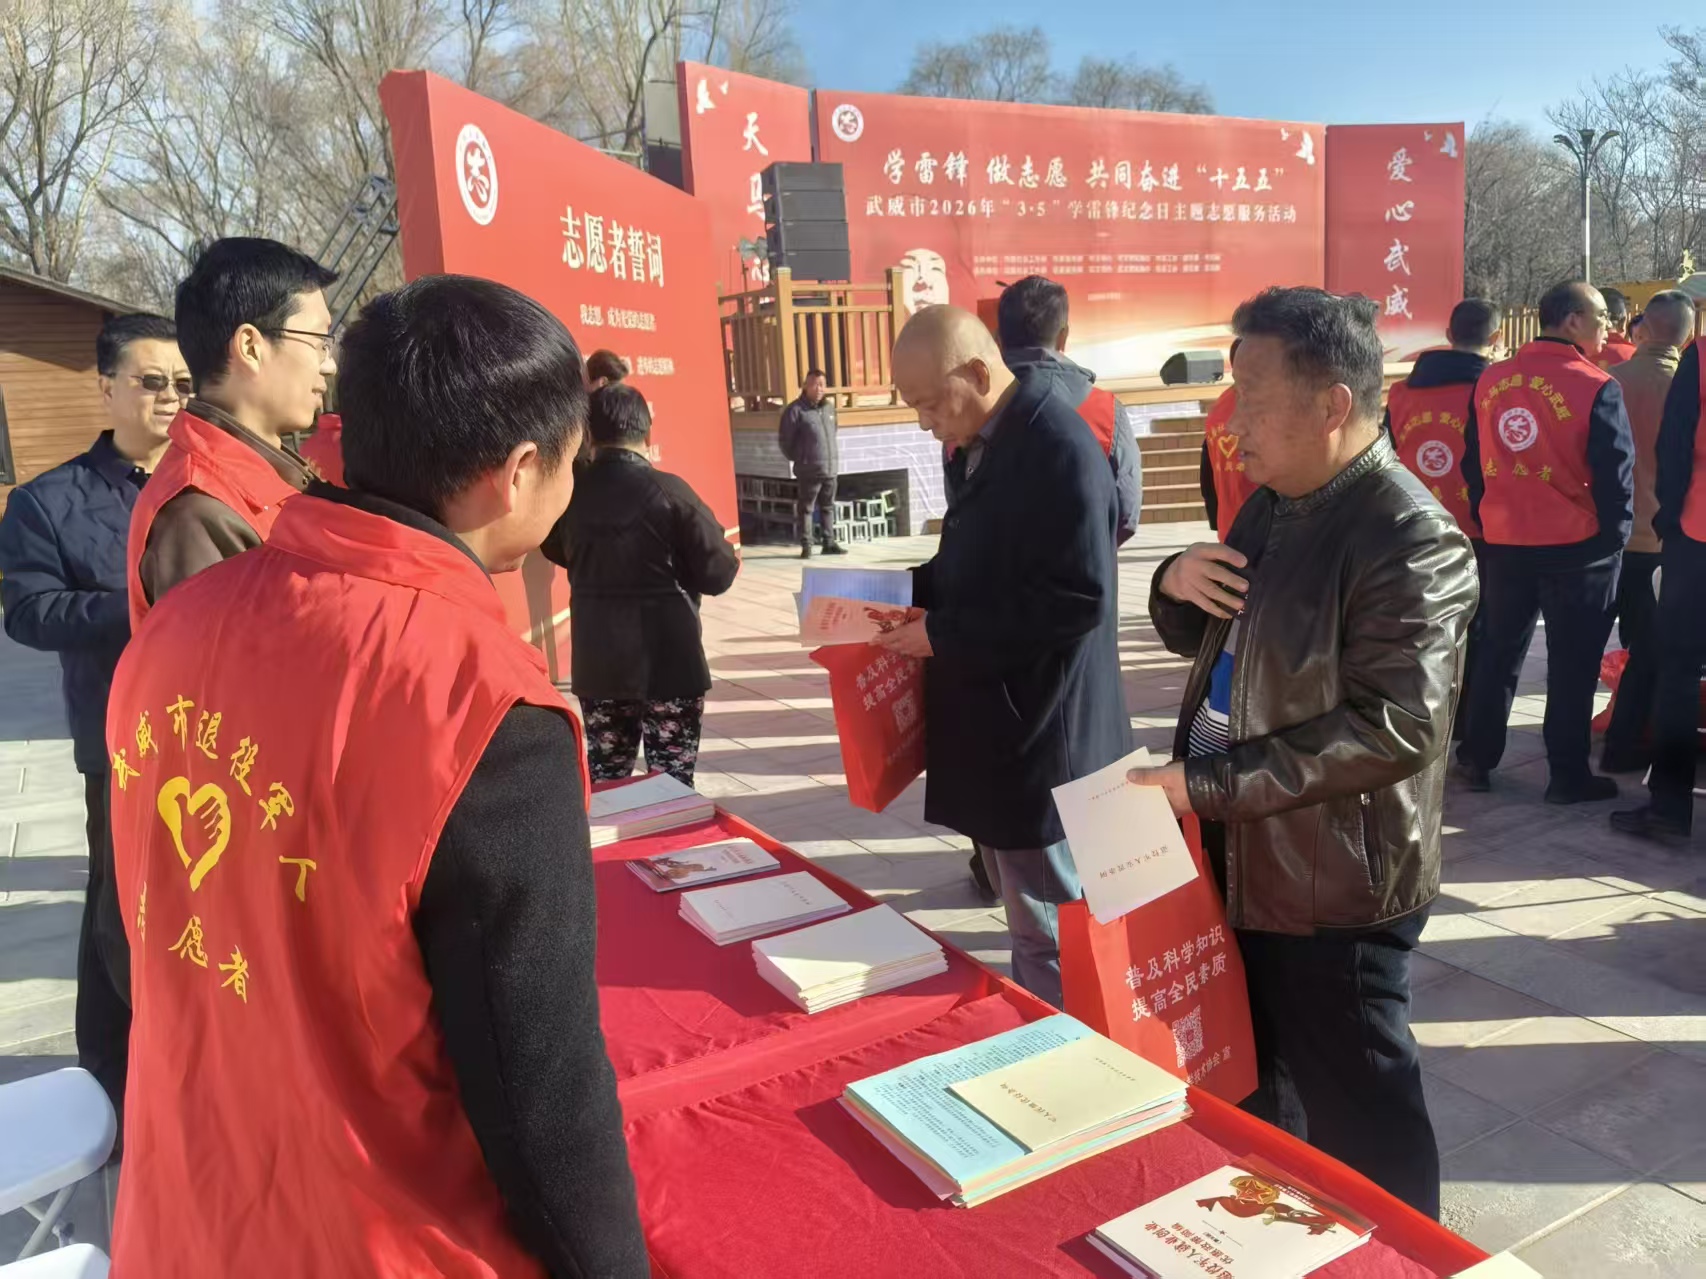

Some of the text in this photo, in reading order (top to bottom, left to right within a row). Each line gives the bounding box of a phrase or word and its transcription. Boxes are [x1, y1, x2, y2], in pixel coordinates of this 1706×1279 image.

[884, 149, 1285, 192] 学雷锋 做志愿 共同奋进 “十五五”
[560, 205, 664, 288] 志愿者誓词
[1384, 148, 1414, 320] 爱心武威
[1126, 924, 1225, 990] 普及科学知识
[1132, 952, 1227, 1022] 提高全民素质
